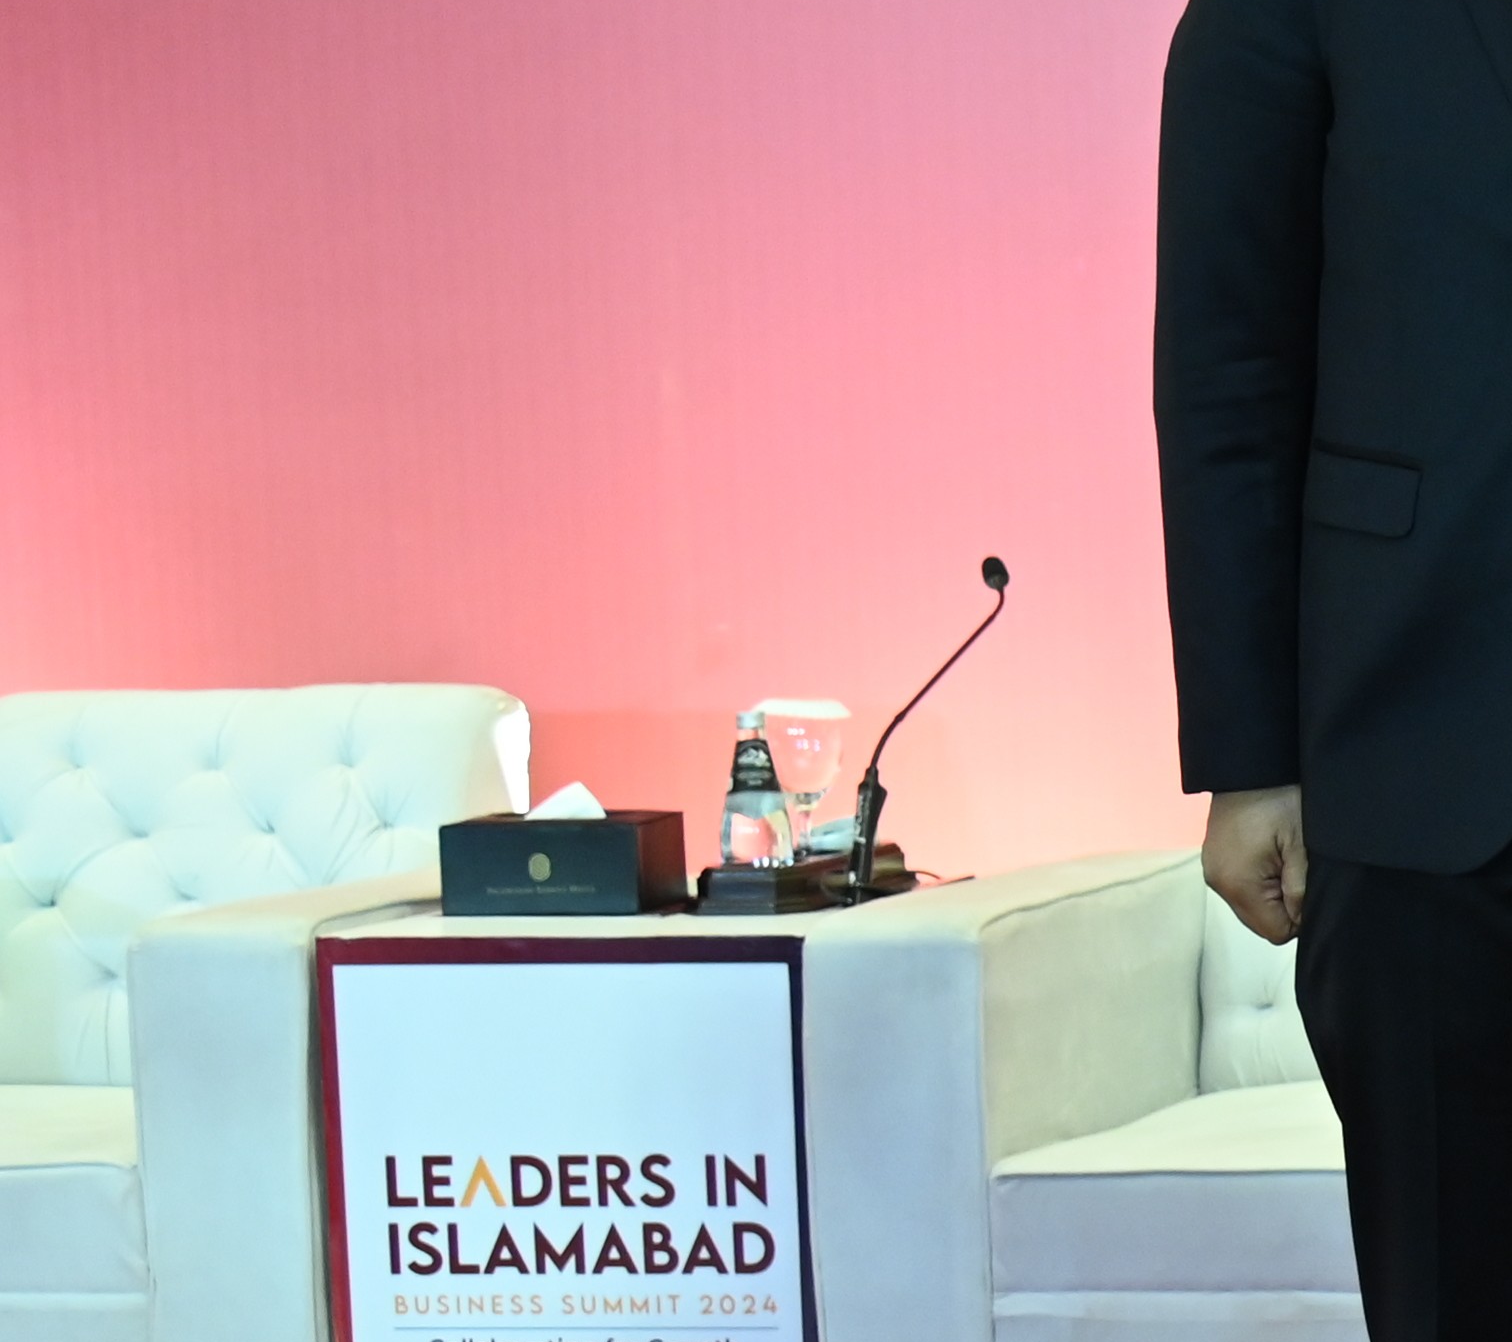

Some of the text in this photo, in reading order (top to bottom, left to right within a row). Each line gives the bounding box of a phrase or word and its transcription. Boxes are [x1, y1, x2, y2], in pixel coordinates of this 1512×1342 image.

[386, 1154, 768, 1208] LEADERS IN
[389, 1222, 775, 1276] ISLAMABAD
[394, 1294, 779, 1315] BUSINESS SUMMIT 2024
